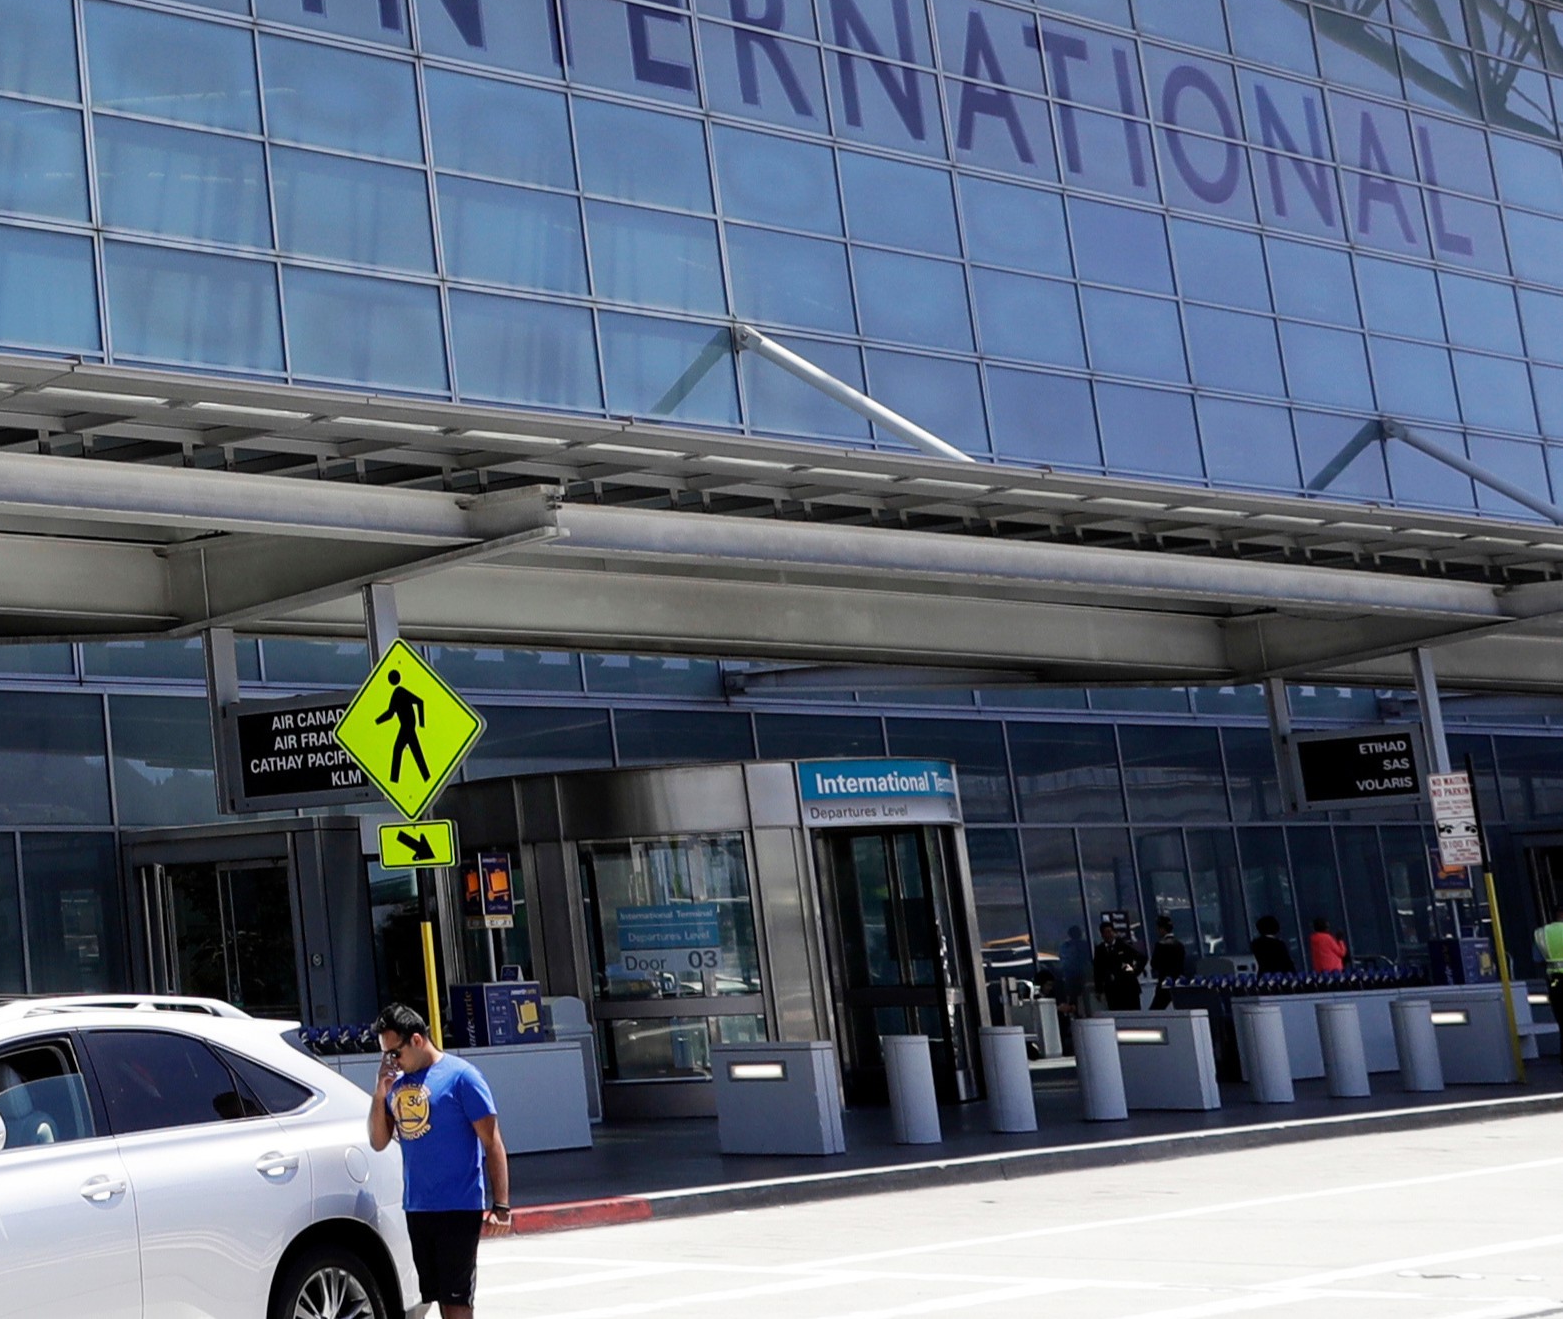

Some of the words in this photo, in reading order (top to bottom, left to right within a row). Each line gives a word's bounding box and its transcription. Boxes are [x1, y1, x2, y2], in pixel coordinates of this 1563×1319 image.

[272, 715, 294, 730] AIR
[297, 709, 345, 727] CANAD
[274, 735, 297, 751] AIR
[301, 731, 337, 748] FRAN
[1359, 740, 1407, 754] ETIHAD
[251, 755, 303, 773] CATHAY
[308, 750, 356, 768] PACIFI
[1383, 758, 1410, 770] SAS
[331, 769, 362, 786] KLM
[816, 771, 929, 794] International
[1356, 777, 1413, 791] VOLARIS
[810, 806, 877, 820] Departures
[882, 804, 908, 816] Level
[620, 911, 673, 920] International
[676, 909, 713, 918] Terminal
[628, 932, 681, 942] Departures
[685, 931, 709, 939] Level
[625, 956, 667, 971] Door
[688, 950, 717, 968] 03
